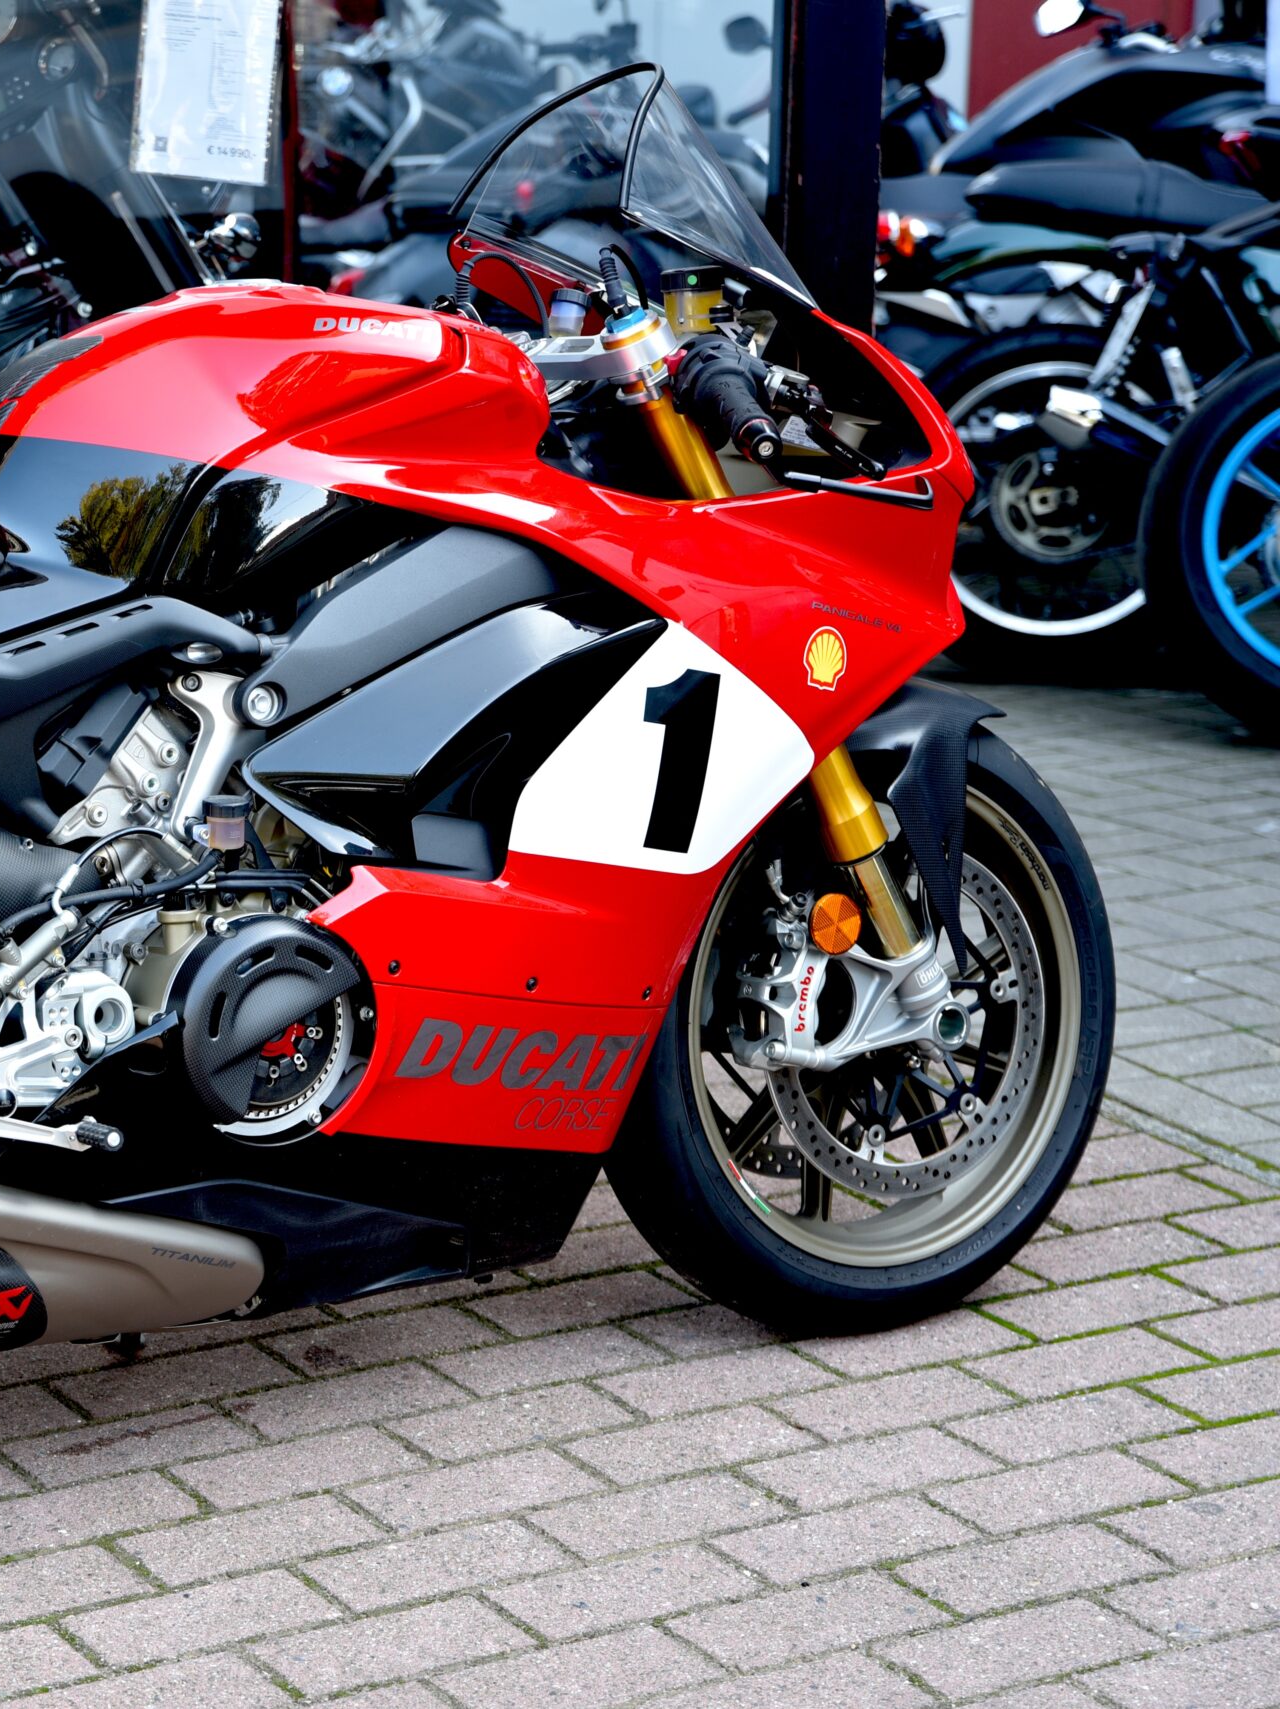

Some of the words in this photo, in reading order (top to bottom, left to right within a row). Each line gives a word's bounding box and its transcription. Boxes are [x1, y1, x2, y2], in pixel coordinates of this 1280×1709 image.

[313, 316, 434, 344] DUCATI
[643, 667, 721, 854] 1
[794, 965, 816, 1033] brembo
[394, 1017, 648, 1092] DUCATI
[514, 1096, 618, 1131] CORSE
[151, 1247, 237, 1269] TITANIUM
